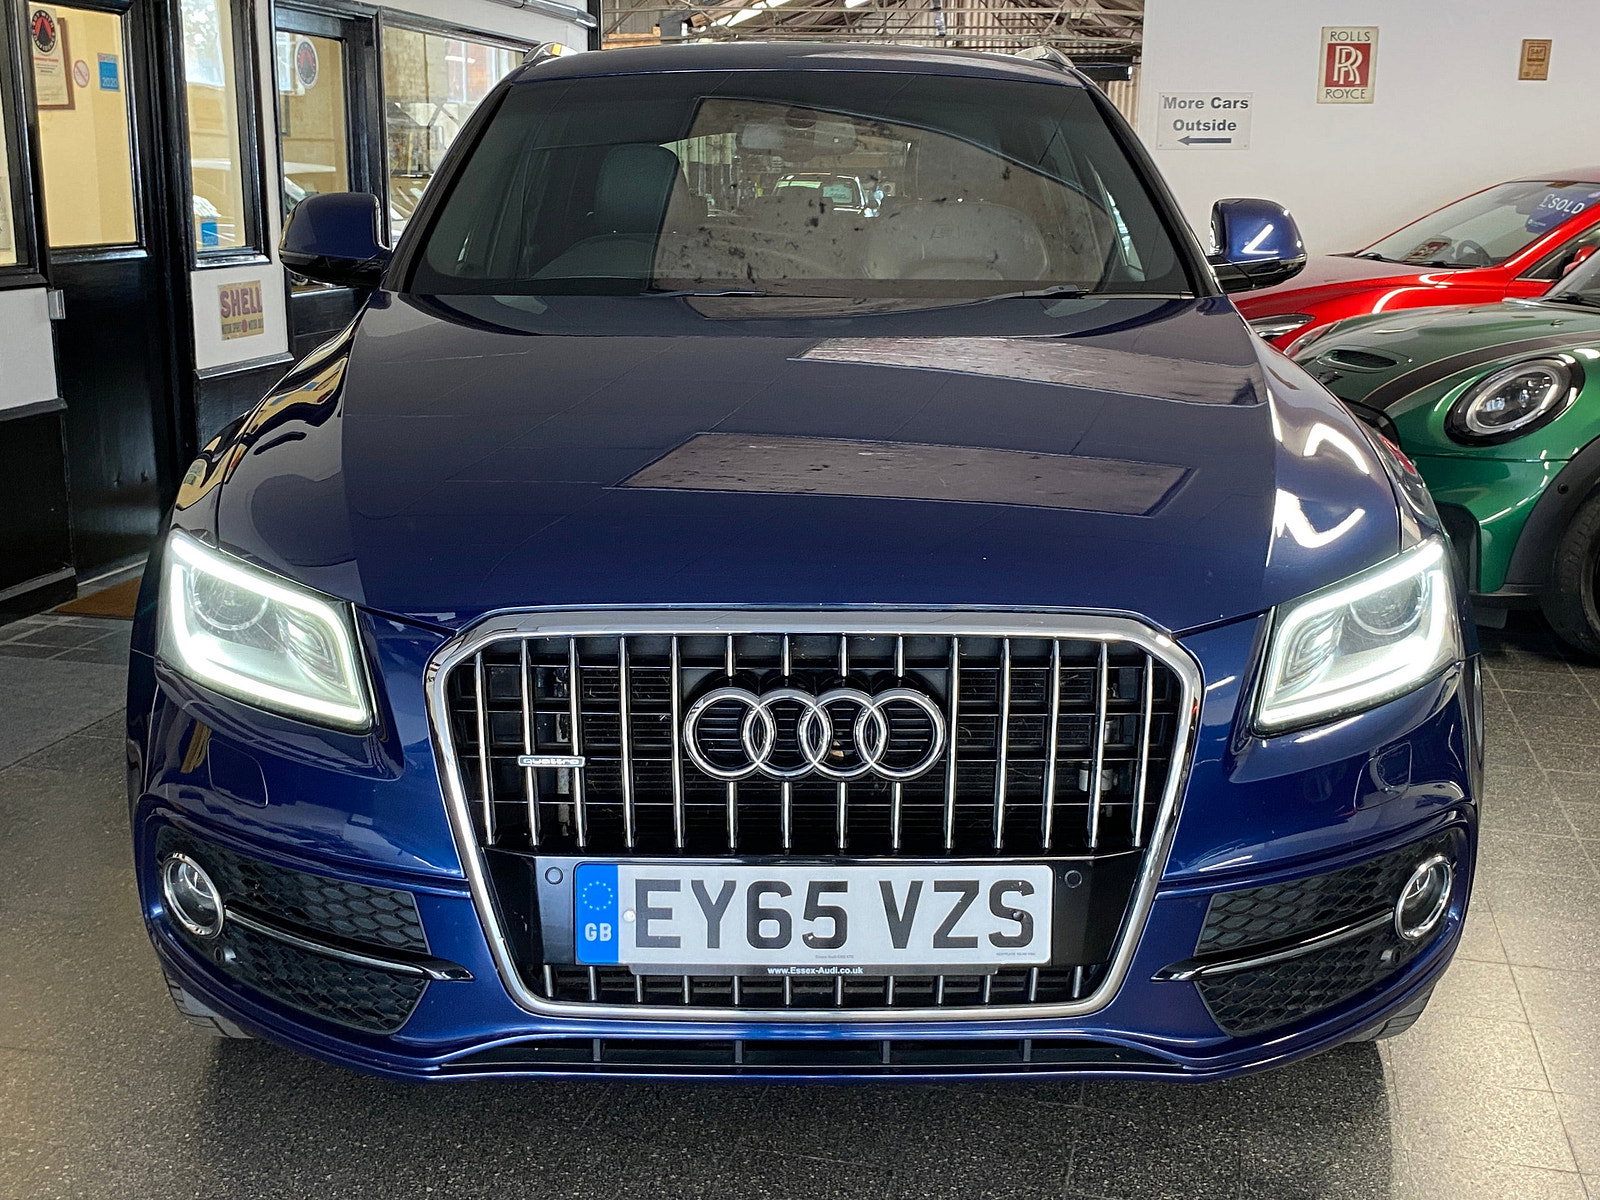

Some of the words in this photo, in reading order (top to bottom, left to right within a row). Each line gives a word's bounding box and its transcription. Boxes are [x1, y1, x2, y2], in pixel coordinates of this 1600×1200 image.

[1330, 31, 1370, 41] ROLLS
[1325, 88, 1367, 99] ROYCE
[1163, 96, 1205, 109] More
[1210, 96, 1249, 109] Cars
[1172, 119, 1237, 131] Outside
[220, 287, 263, 318] SHELL
[521, 757, 581, 766] quattro
[635, 879, 848, 949] EY65
[878, 879, 1035, 949] VZS
[584, 923, 612, 941] GB
[767, 966, 864, 975] www.Essex-Audi.co.uk
